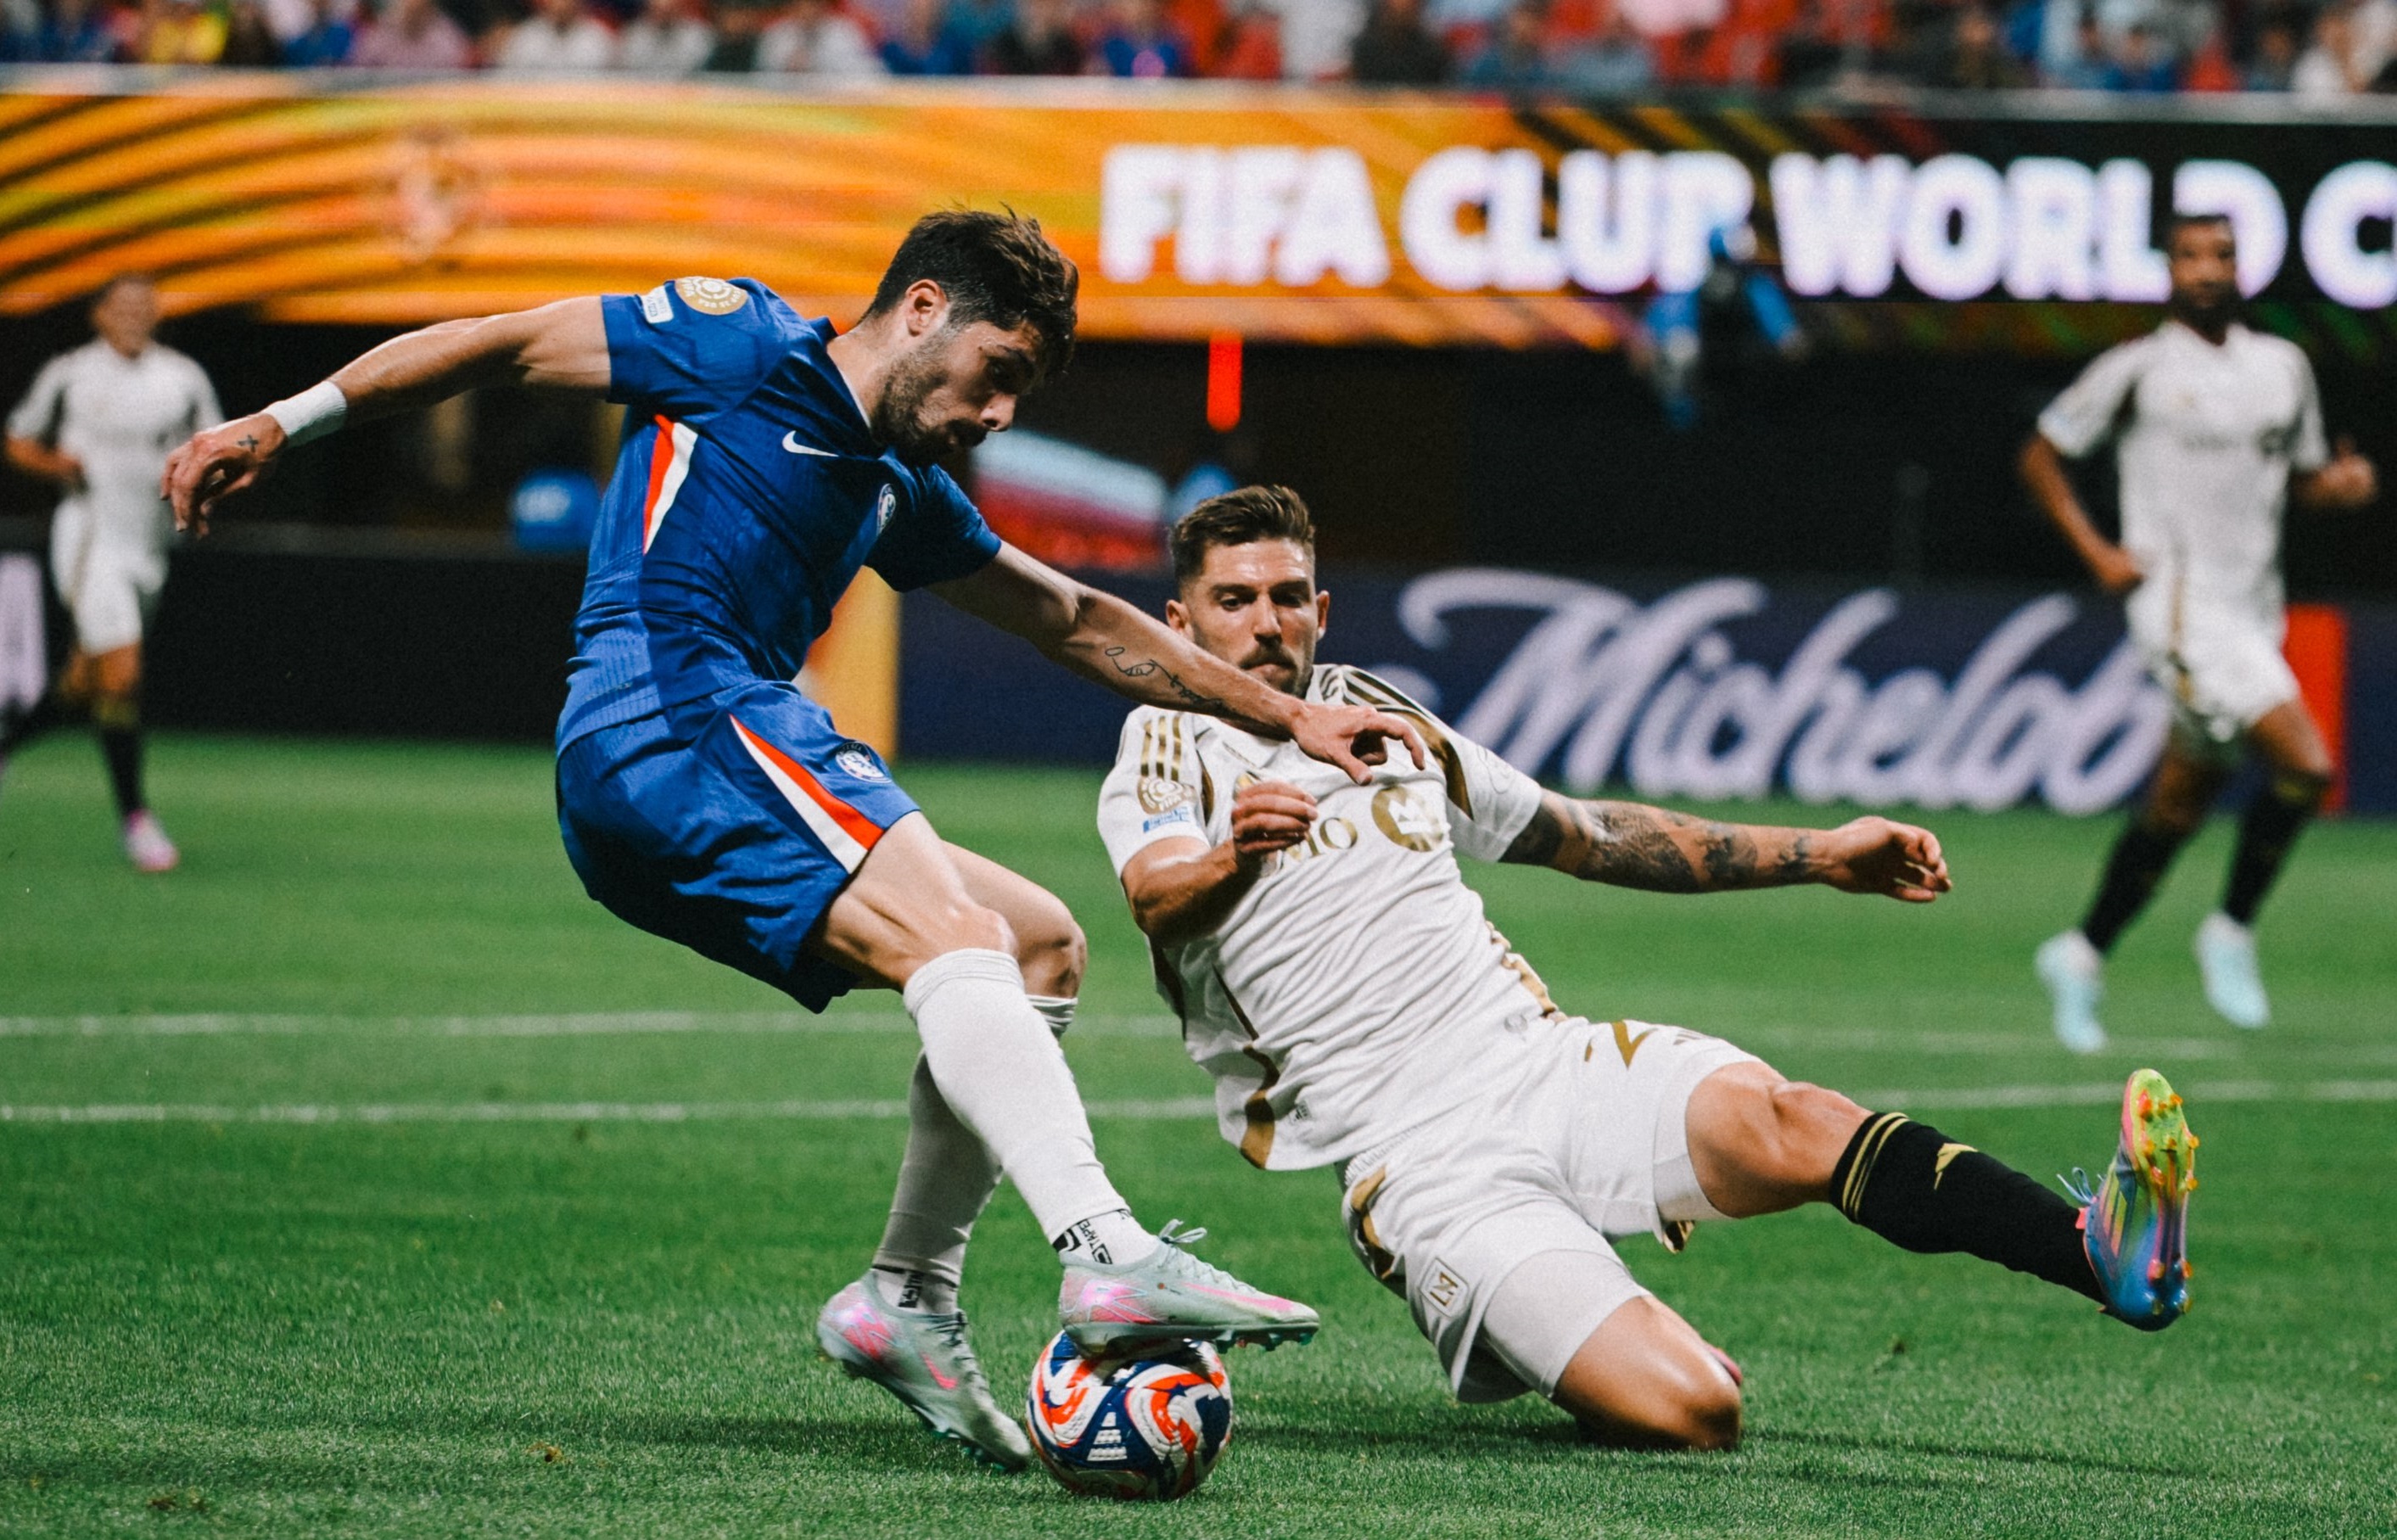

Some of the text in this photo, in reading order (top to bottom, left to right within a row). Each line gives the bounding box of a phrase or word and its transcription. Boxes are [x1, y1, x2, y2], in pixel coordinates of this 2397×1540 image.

[1100, 143, 1391, 288] FIFA
[1770, 152, 2288, 302] WORLD
[1368, 567, 2169, 815] Michelob
[1076, 1218, 1100, 1250] TAPE
